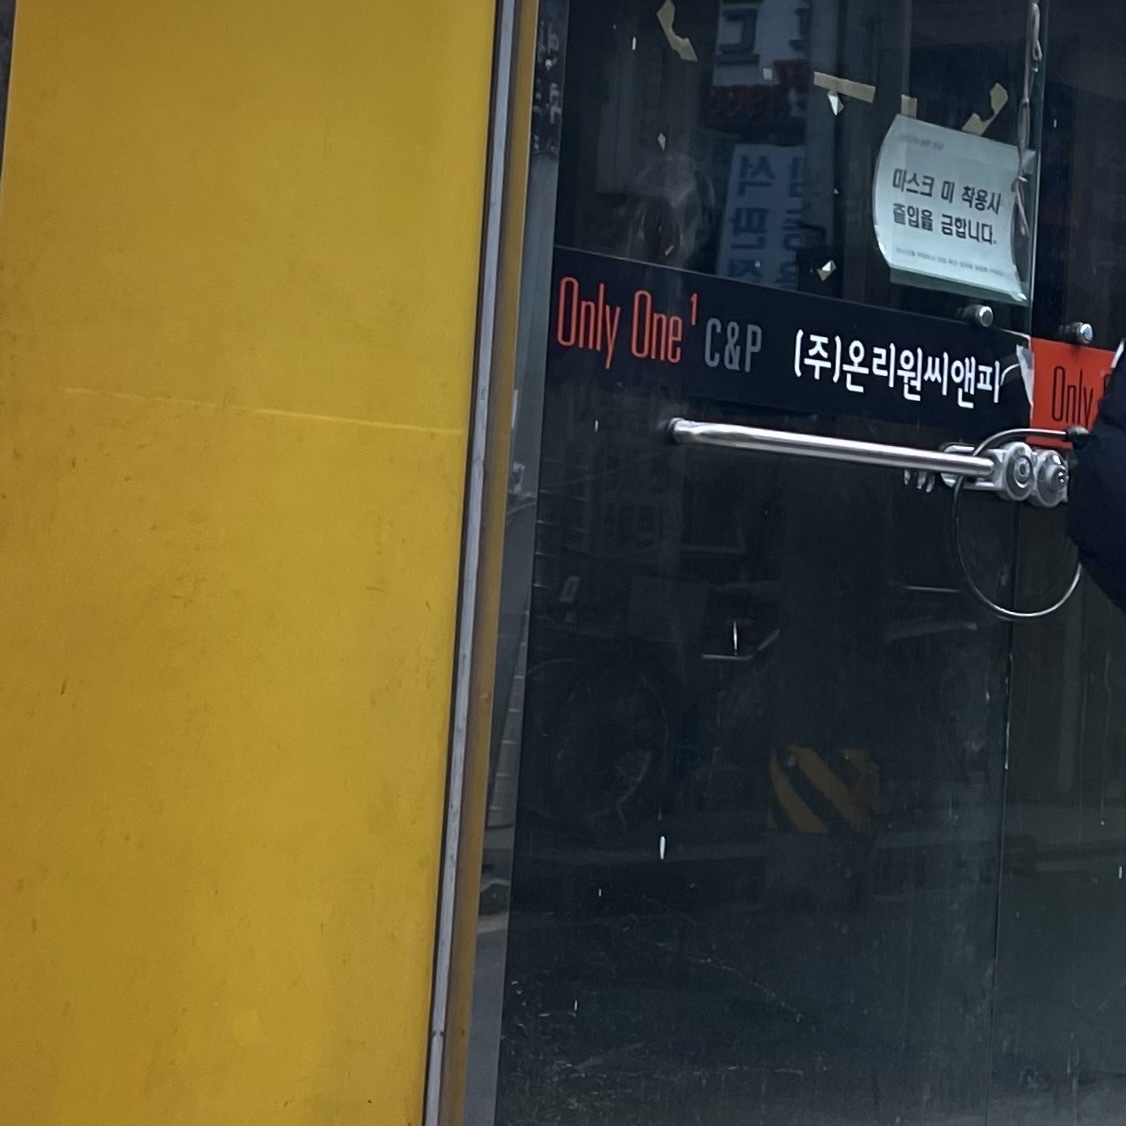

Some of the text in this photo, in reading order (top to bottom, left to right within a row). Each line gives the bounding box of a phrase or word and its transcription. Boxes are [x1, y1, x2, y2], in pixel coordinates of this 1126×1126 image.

[892, 167, 1002, 215] 마스크 미 착용시
[940, 213, 998, 246] 금합니다.
[556, 276, 621, 369] Only
[704, 317, 763, 373] C&P
[794, 328, 1000, 409] (주)온리원씨앤피
[1051, 365, 1095, 429] Only
